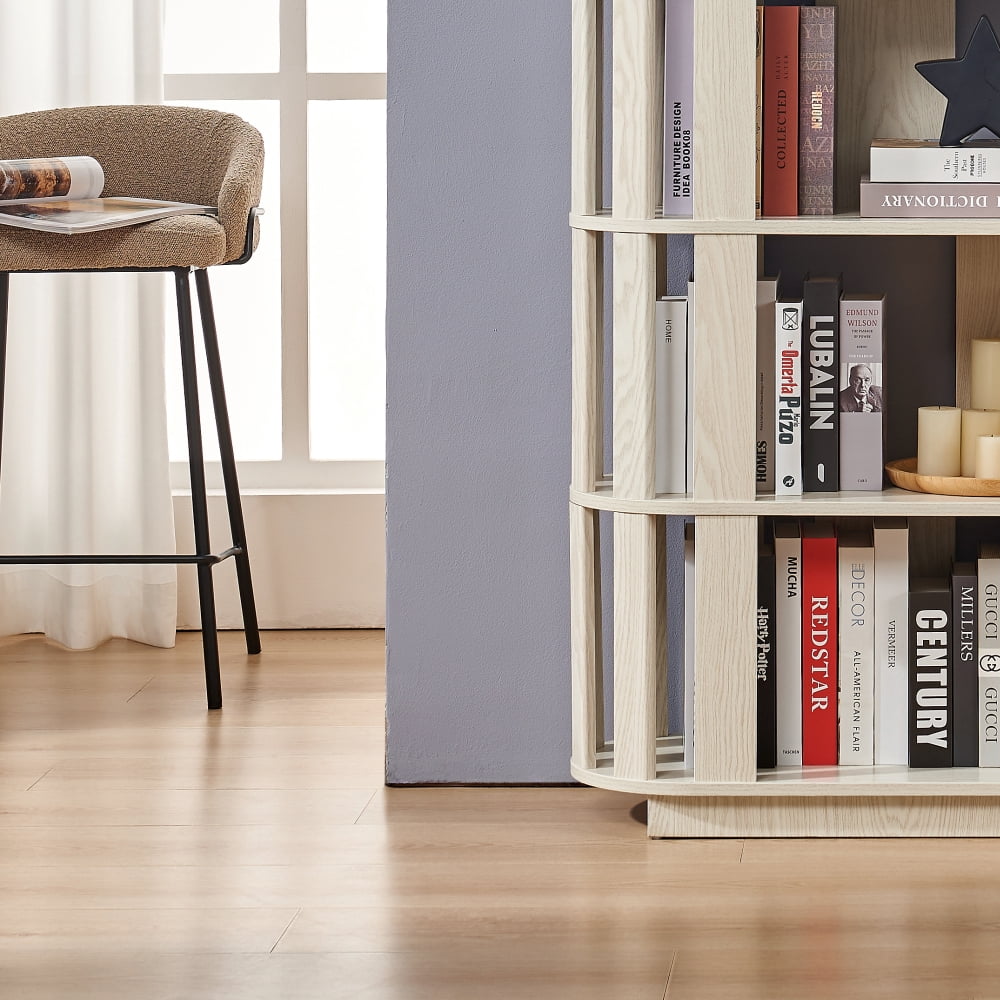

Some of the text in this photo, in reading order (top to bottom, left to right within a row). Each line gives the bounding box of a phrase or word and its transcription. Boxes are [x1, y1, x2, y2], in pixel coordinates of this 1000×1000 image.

[777, 89, 786, 169] COLLECTED
[812, 91, 823, 129] REDOCN
[673, 140, 681, 197] FURNITURE
[683, 130, 691, 169] BOOK08
[881, 195, 987, 208] DICTIONARY
[781, 350, 800, 394] Omerta
[809, 315, 834, 430] LUBALIN
[779, 396, 800, 445] Puzo
[756, 440, 767, 483] HOMES
[788, 556, 798, 598] MUCHA
[961, 586, 974, 662] MILLERS
[985, 584, 998, 640] GUCCI
[757, 606, 770, 682] Harry Potter
[811, 596, 829, 713] REDSTAR
[916, 609, 948, 749] CENTURY
[985, 687, 998, 743] GUCCI
